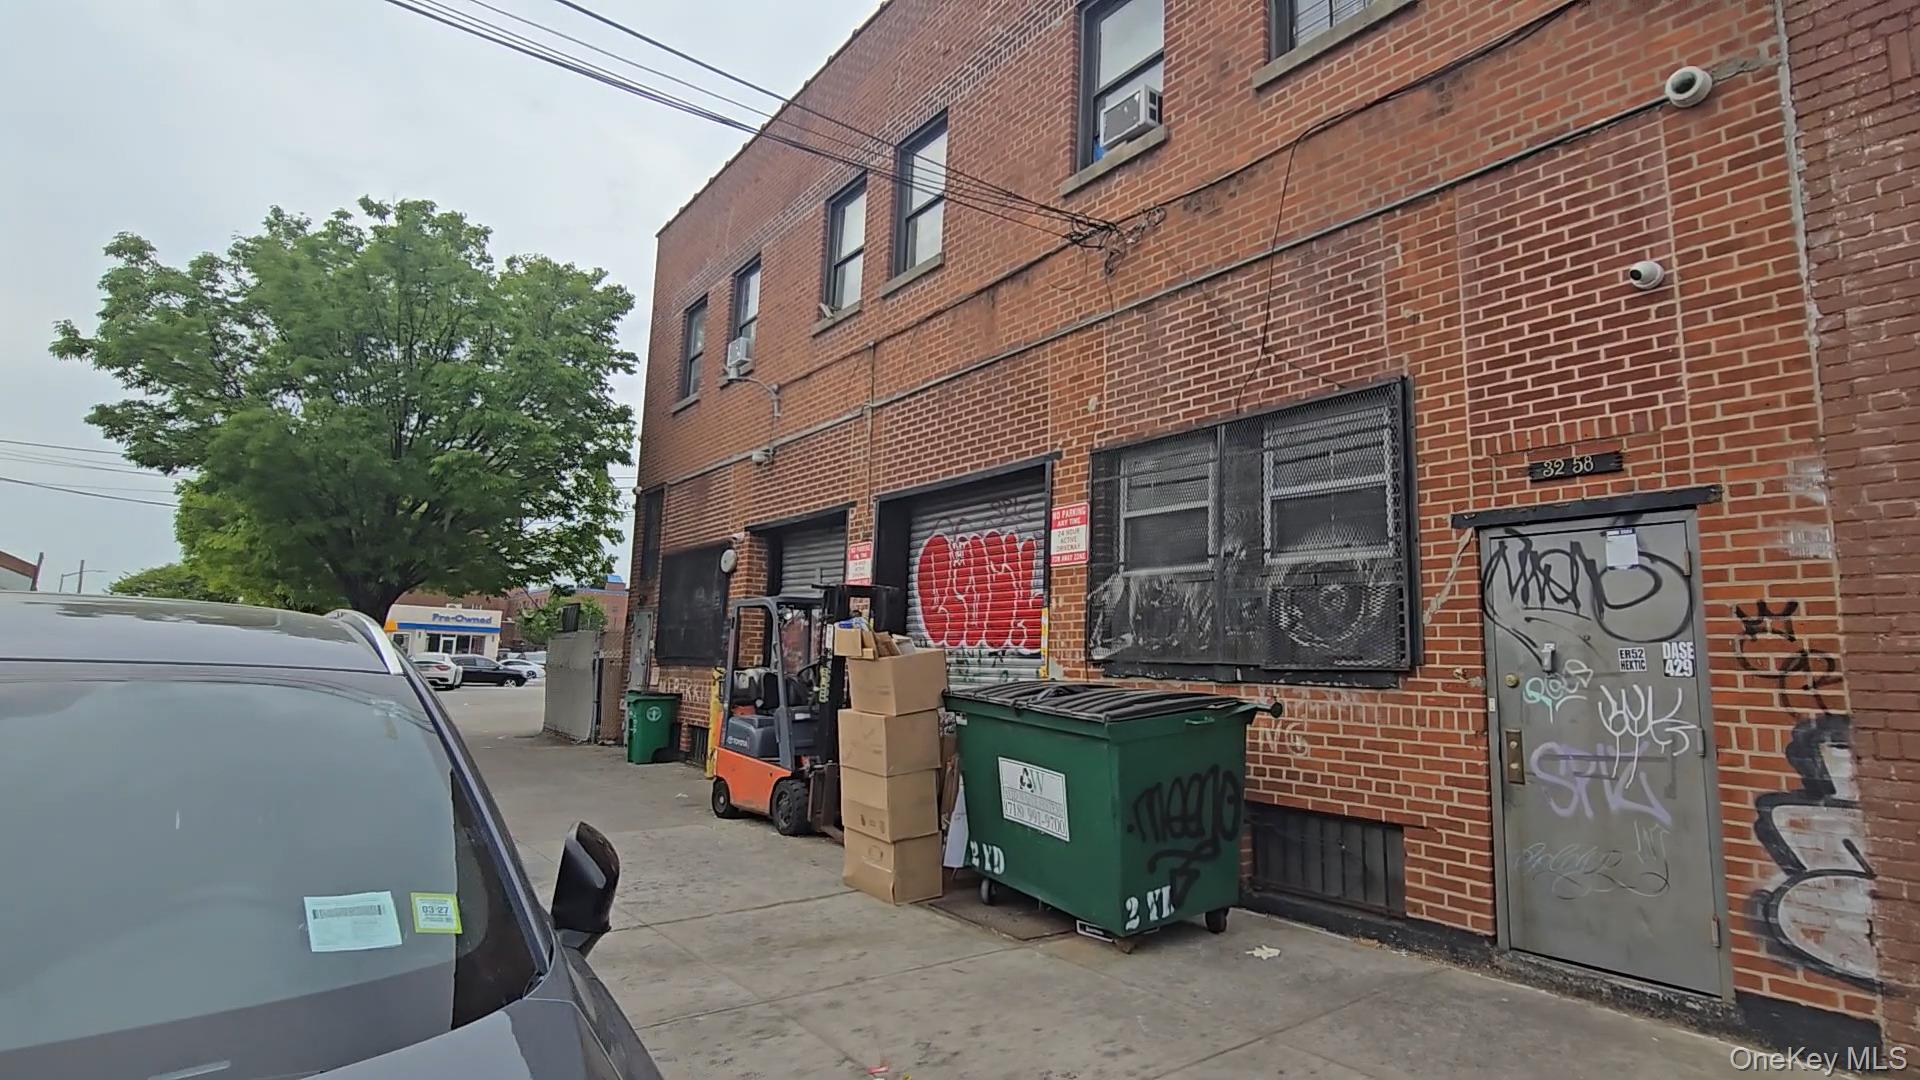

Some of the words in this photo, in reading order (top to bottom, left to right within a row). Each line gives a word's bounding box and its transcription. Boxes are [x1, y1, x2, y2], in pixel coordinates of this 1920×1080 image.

[1543, 459, 1565, 477] 32
[1572, 455, 1594, 473] 58
[1052, 510, 1060, 521] NO
[1061, 507, 1086, 519] PARKING
[432, 613, 492, 624] Pre-Owned
[1619, 648, 1644, 660] ER52
[1662, 641, 1695, 660] DASE
[1620, 660, 1646, 670] HEKTIC
[1664, 659, 1694, 677] 429
[970, 841, 980, 867] 2
[983, 843, 1005, 875] YD
[1125, 896, 1140, 931] 2
